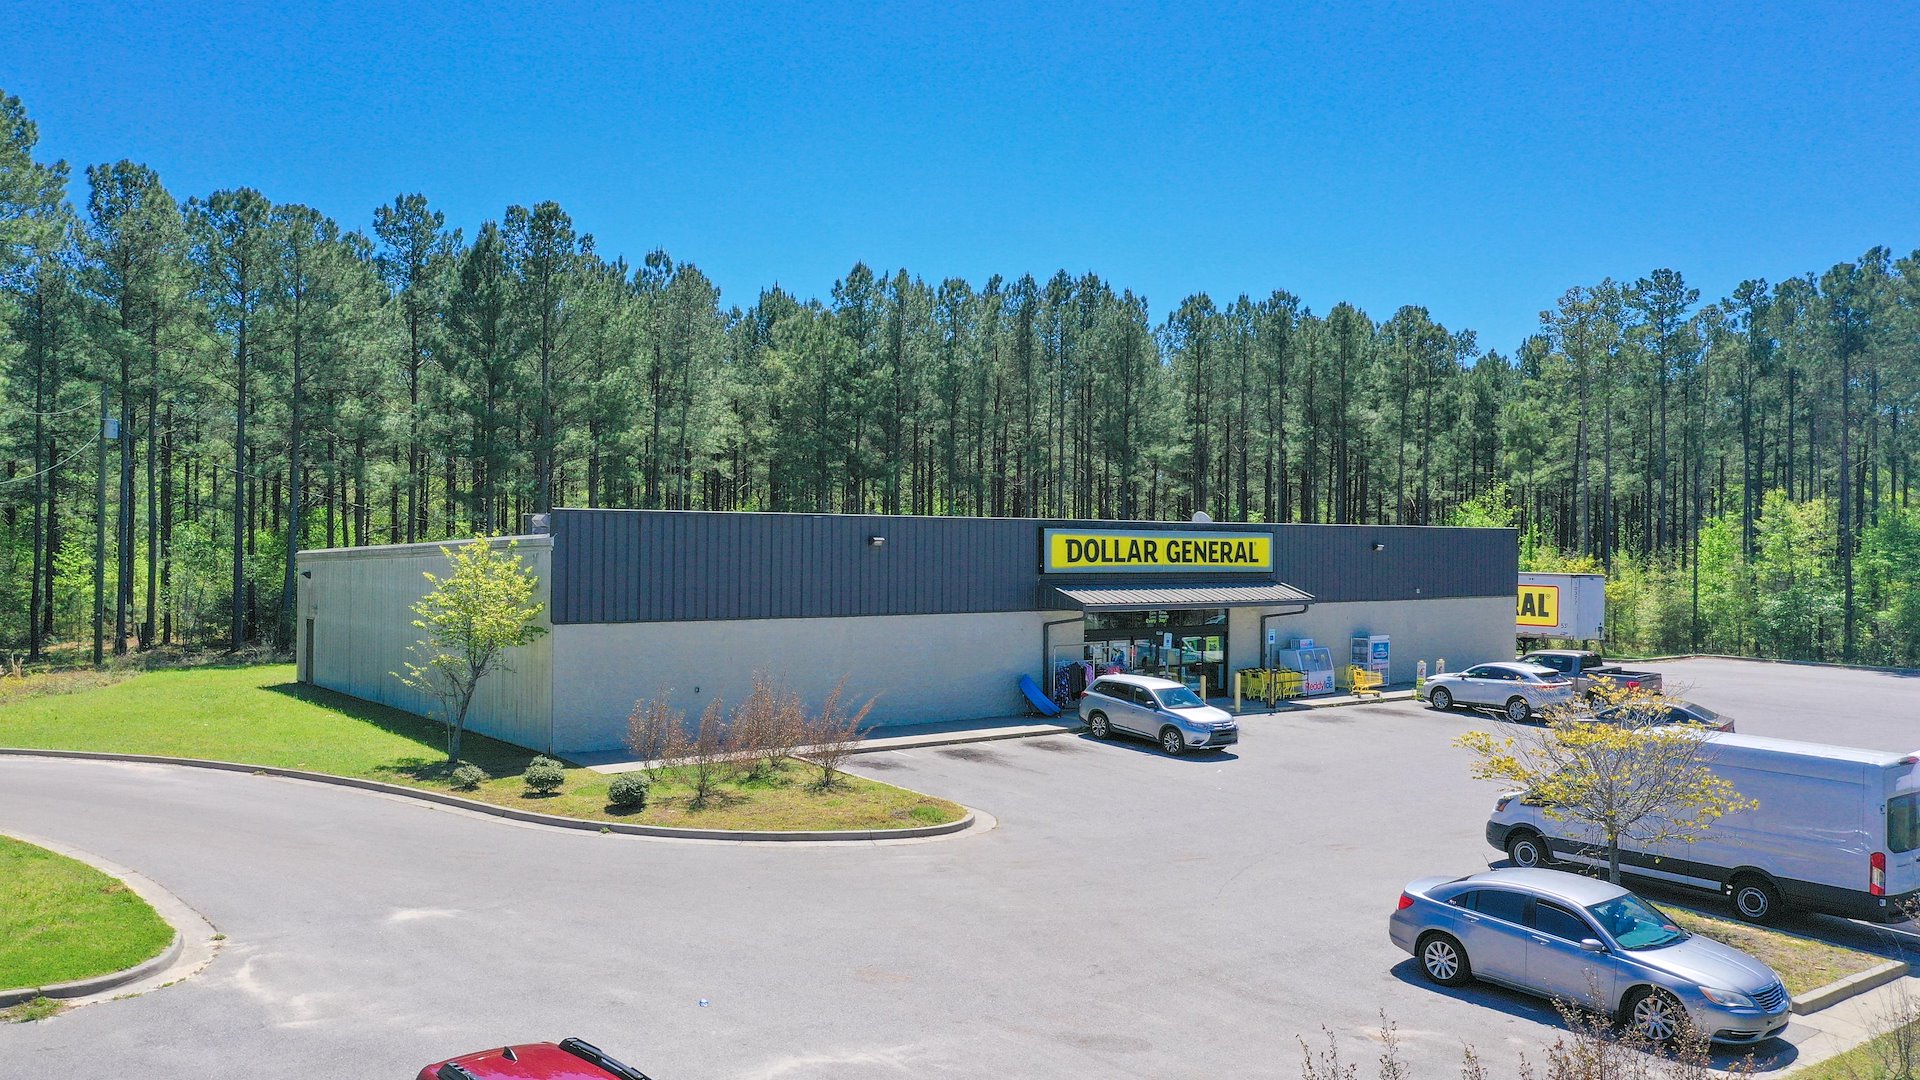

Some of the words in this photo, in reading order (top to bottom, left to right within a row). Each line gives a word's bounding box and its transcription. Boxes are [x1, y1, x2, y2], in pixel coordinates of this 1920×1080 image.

[1065, 539, 1158, 563] DOLLAR
[1166, 540, 1259, 563] GENERAL
[1516, 592, 1549, 617] AL
